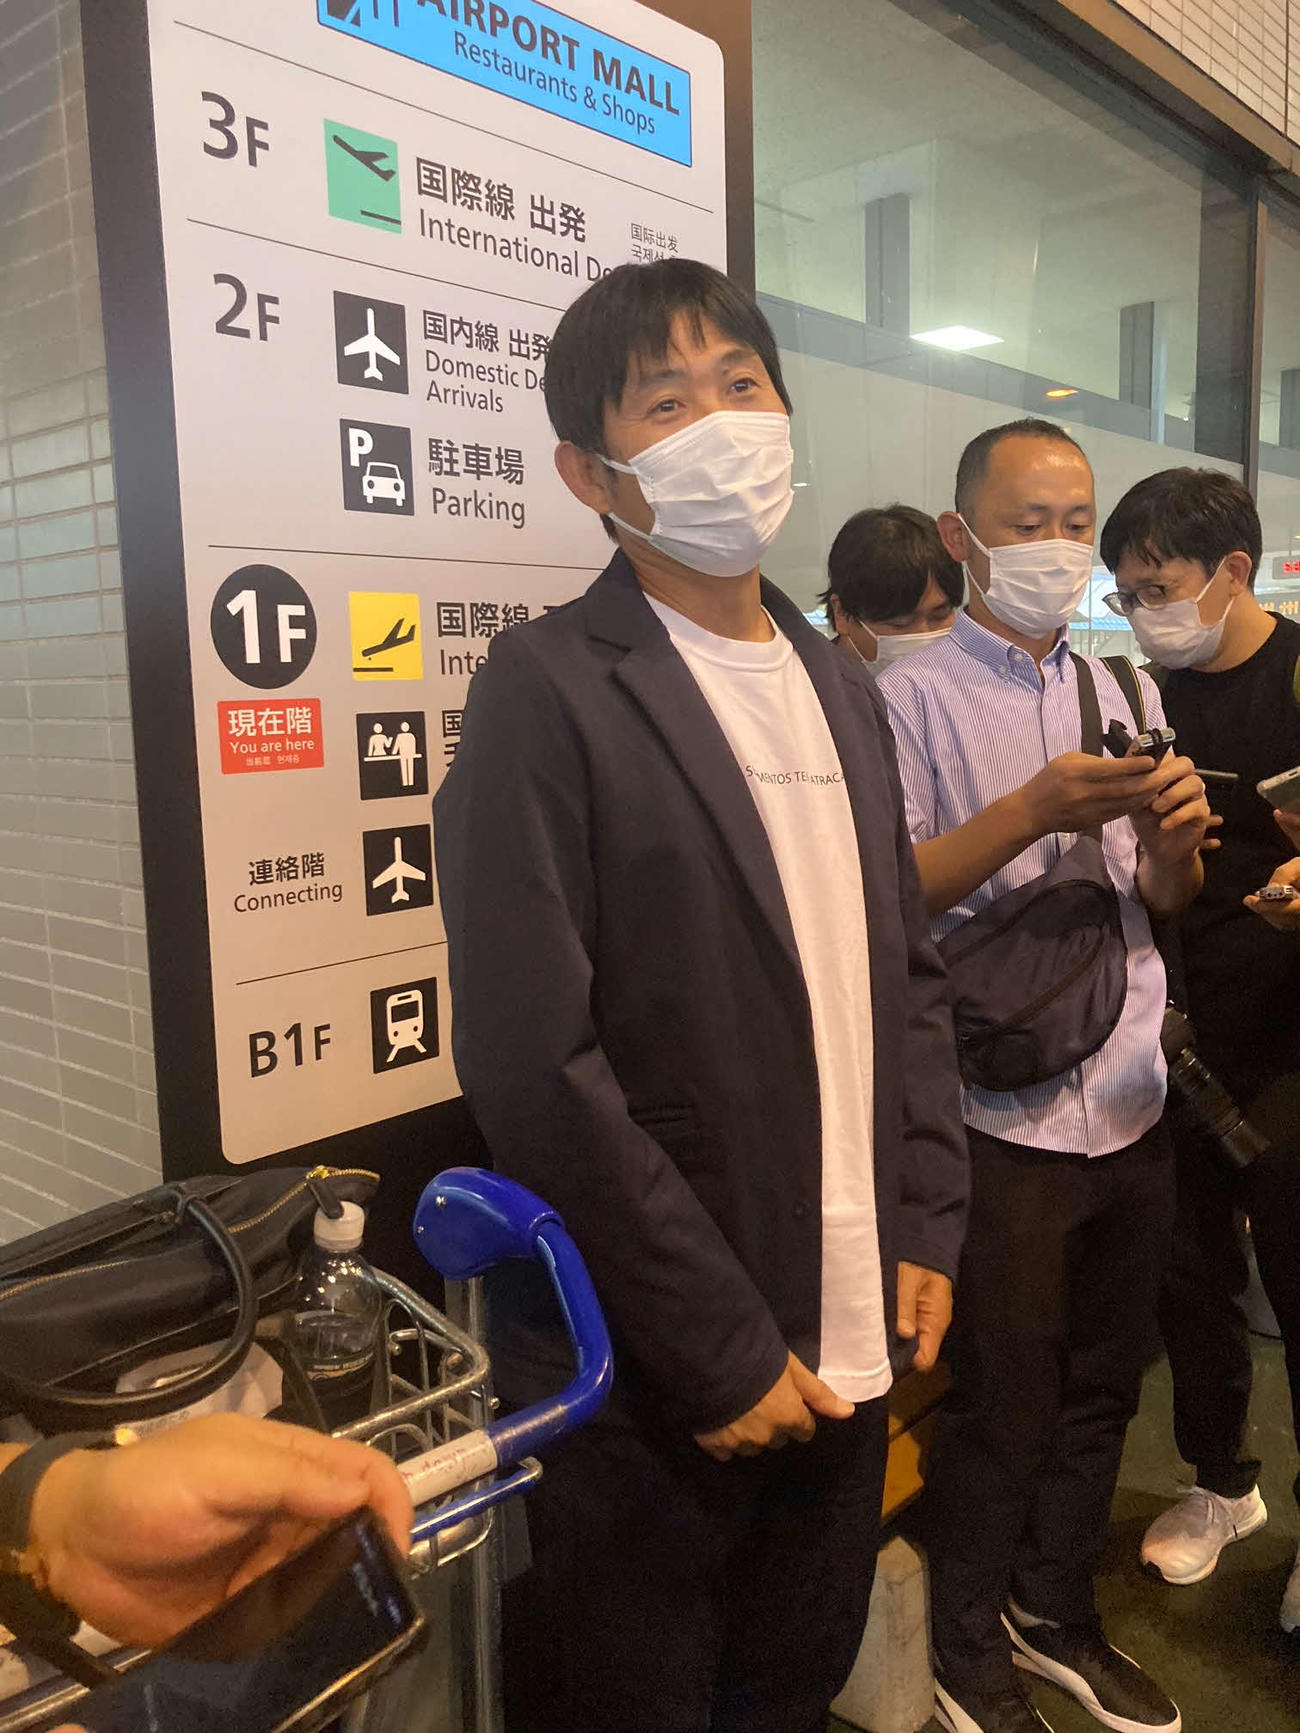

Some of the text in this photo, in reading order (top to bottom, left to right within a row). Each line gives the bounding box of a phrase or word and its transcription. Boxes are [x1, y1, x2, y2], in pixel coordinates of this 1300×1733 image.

[454, 31, 656, 135] Restaurants & Shops
[593, 48, 680, 116] MALL
[201, 91, 269, 168] 3F
[416, 157, 587, 243] 国際線 出発
[420, 208, 579, 278] International
[213, 273, 281, 342] 2F
[423, 309, 551, 361] 国内線 出発
[426, 349, 520, 388] Domestic
[426, 379, 504, 413] Arrivals
[349, 427, 374, 467] P
[428, 438, 524, 486] 駐車場
[433, 488, 526, 530] Parking
[226, 589, 307, 664] 1F
[228, 707, 312, 737] 現在階
[229, 738, 315, 754] You are here
[249, 852, 325, 886] 連絡階
[234, 883, 343, 913] Connecting
[249, 1022, 331, 1078] B1F
